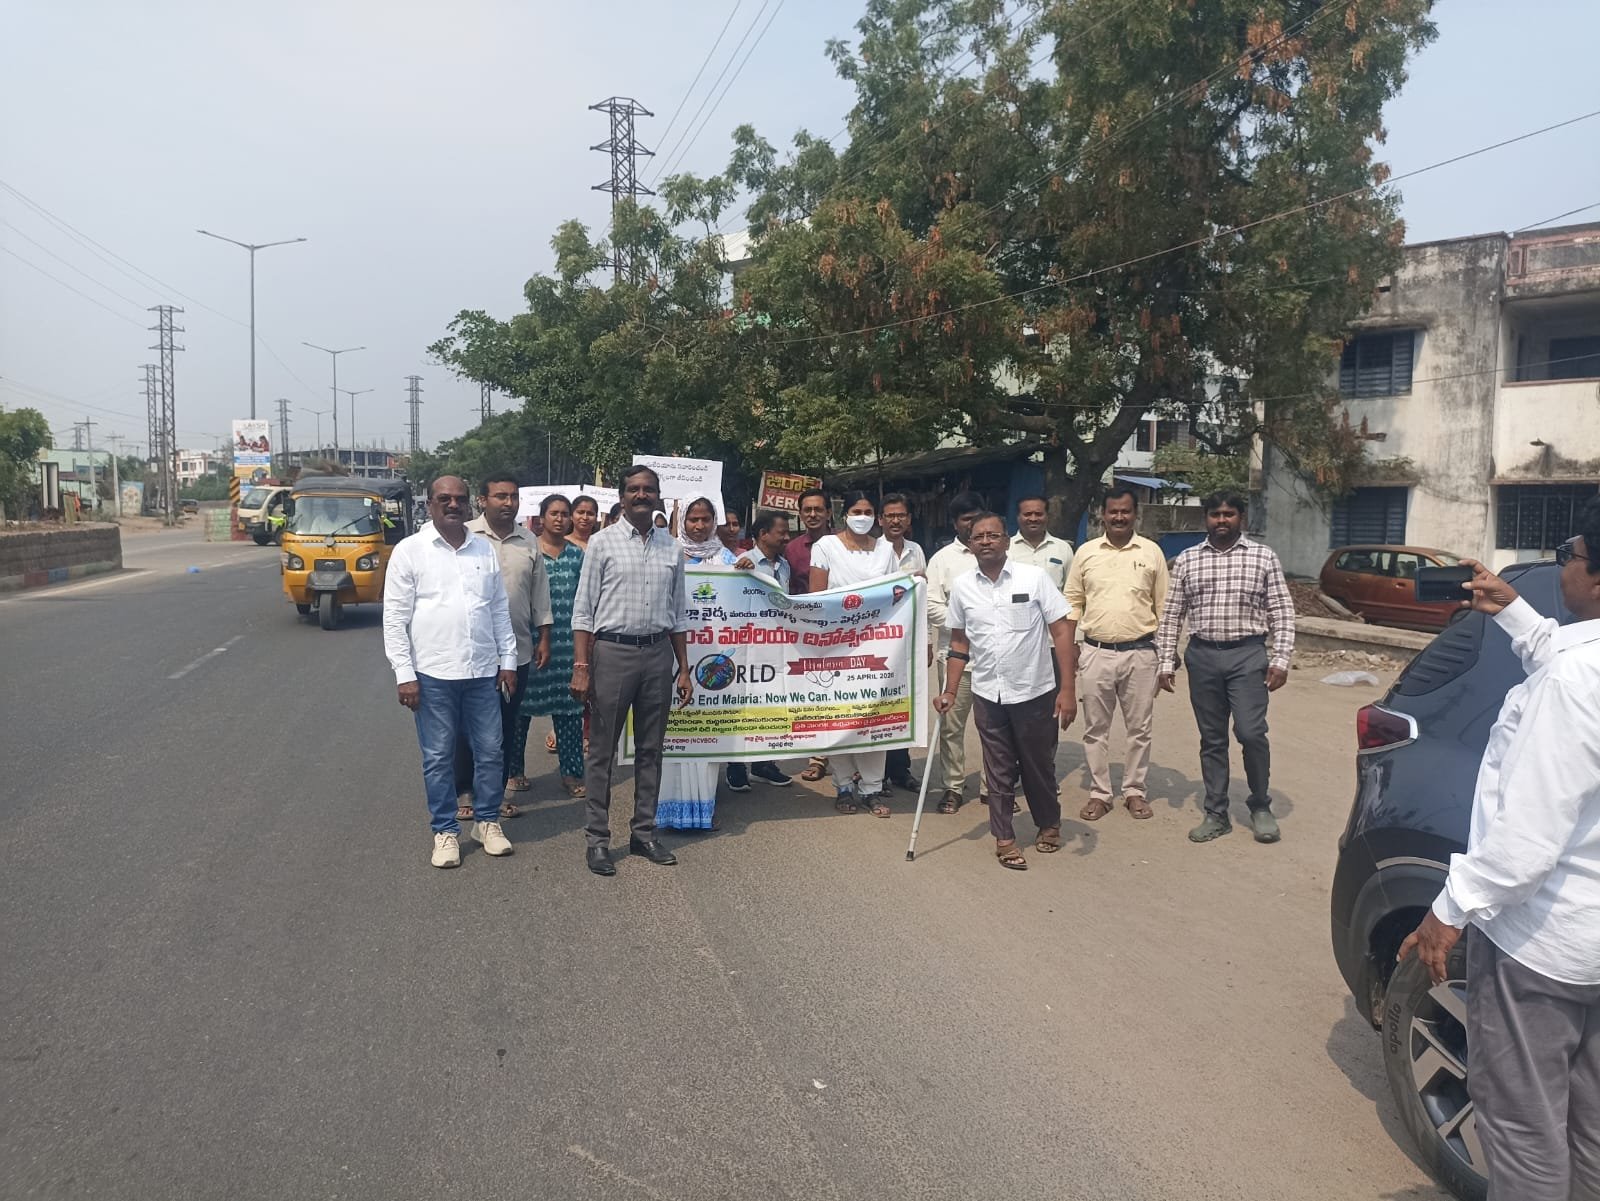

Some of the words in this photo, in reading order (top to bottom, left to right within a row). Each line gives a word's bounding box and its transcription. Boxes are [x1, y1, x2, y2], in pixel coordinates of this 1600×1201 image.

[764, 494, 800, 510] XER
[702, 606, 727, 621] వైద్య
[718, 622, 799, 645] మలేరియా
[803, 623, 903, 648] దినోత్సవము
[850, 657, 866, 668] DAY
[699, 694, 719, 705] End
[722, 693, 762, 705] Malaria:
[765, 692, 787, 703] Now
[790, 692, 805, 703] We
[808, 690, 831, 702] Can.
[834, 690, 857, 701] Now
[860, 688, 877, 698] We
[1388, 1002, 1402, 1055] apollo
